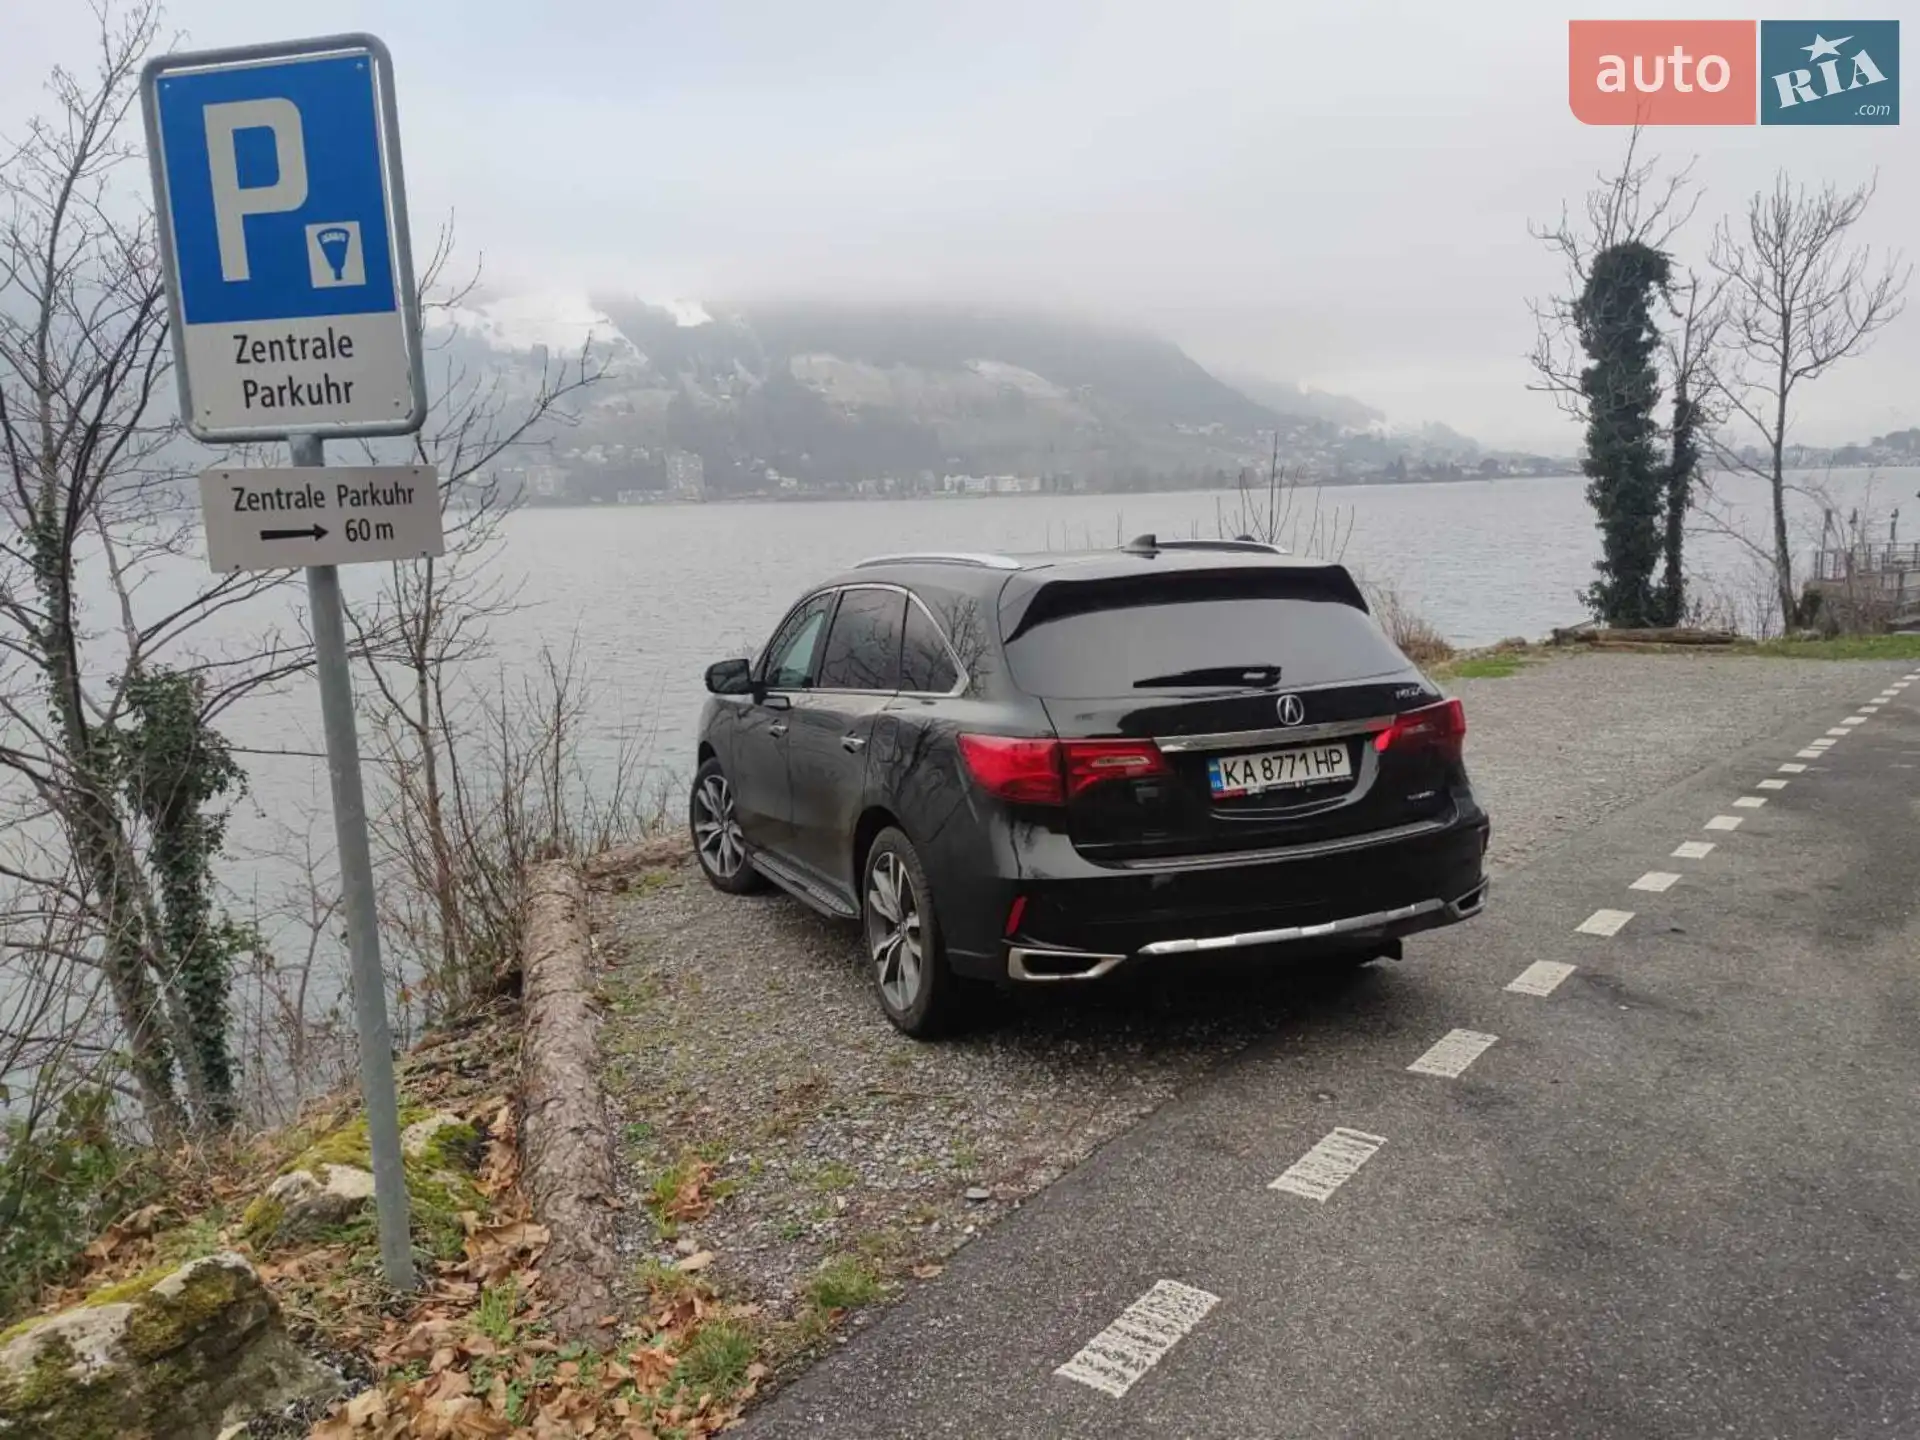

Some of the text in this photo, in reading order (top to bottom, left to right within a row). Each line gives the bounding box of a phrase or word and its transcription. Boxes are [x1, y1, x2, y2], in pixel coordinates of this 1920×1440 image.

[203, 97, 308, 283] P
[233, 326, 354, 364] Zentrale
[243, 373, 354, 409] Parkuhr
[231, 480, 415, 512] Zentrale Parkuhr
[345, 518, 394, 542] 60 m
[1223, 761, 1257, 786] KA
[1261, 754, 1311, 781] 8771
[1314, 749, 1343, 775] HP
